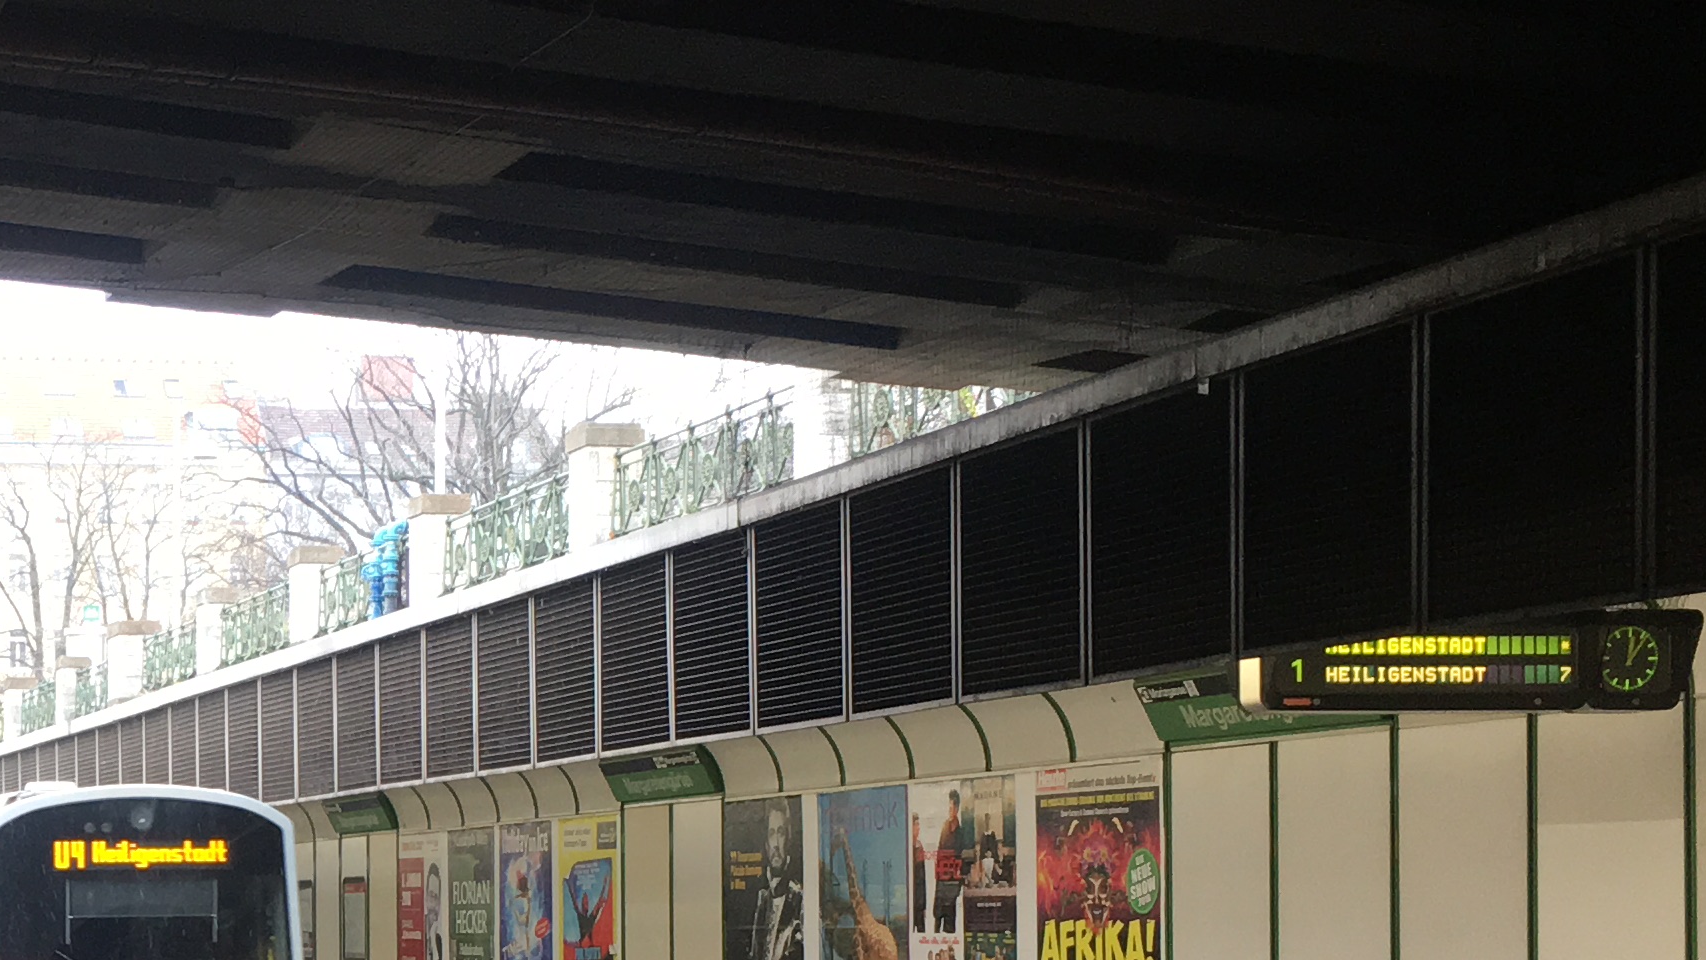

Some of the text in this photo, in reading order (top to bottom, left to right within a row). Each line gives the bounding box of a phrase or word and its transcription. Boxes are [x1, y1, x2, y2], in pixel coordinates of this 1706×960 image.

[1291, 658, 1303, 682] 1
[1325, 665, 1572, 683] HEILIGENSTADT 7
[54, 839, 228, 869] U4 Heiligenstadt
[1131, 862, 1152, 884] NEUE
[453, 880, 490, 904] FLORIAN
[1130, 876, 1155, 900] SHOW
[455, 909, 487, 934] HECKER
